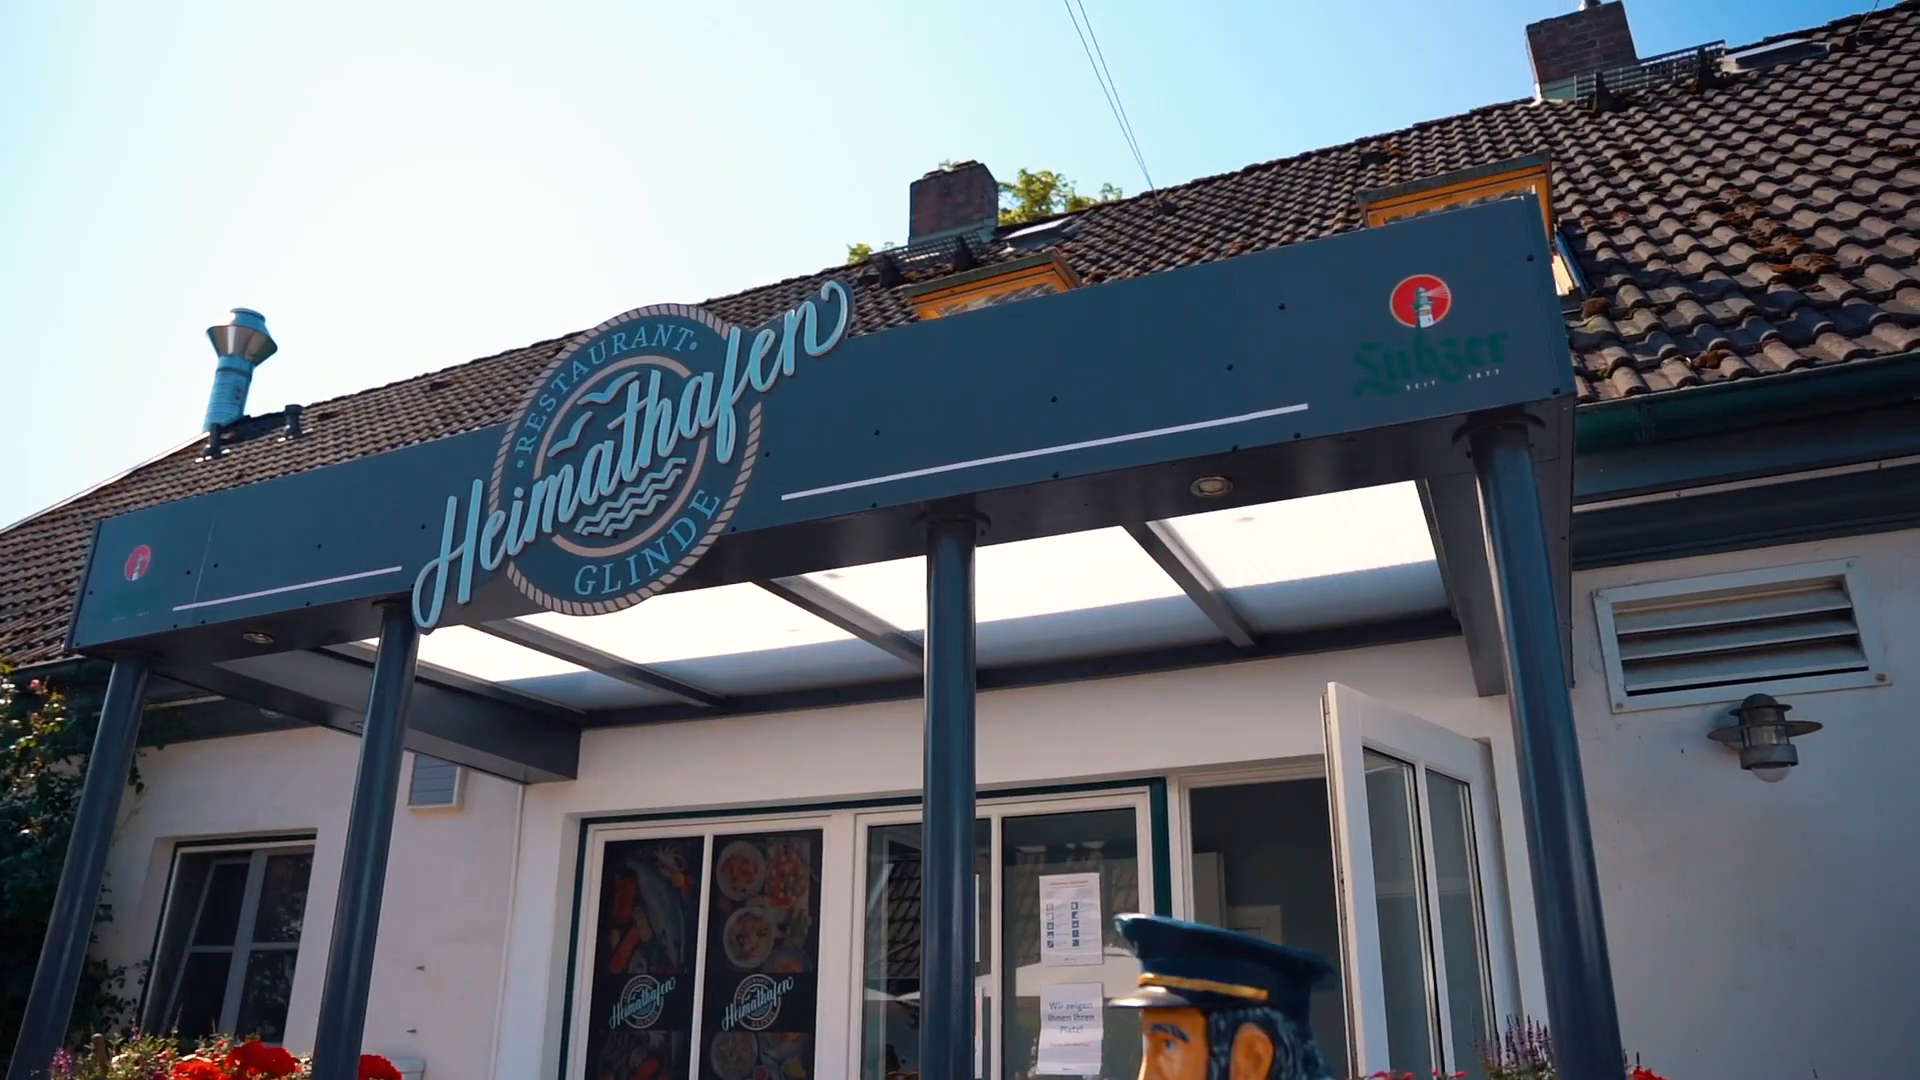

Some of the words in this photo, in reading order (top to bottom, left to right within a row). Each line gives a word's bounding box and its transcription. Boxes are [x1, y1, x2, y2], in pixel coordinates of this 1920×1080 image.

[514, 324, 694, 455] RESTAURANT
[1405, 380, 1437, 391] SEIT
[412, 280, 849, 630] Heimathafen
[574, 488, 721, 596] GLINDE
[721, 976, 794, 1031] Heimathafen
